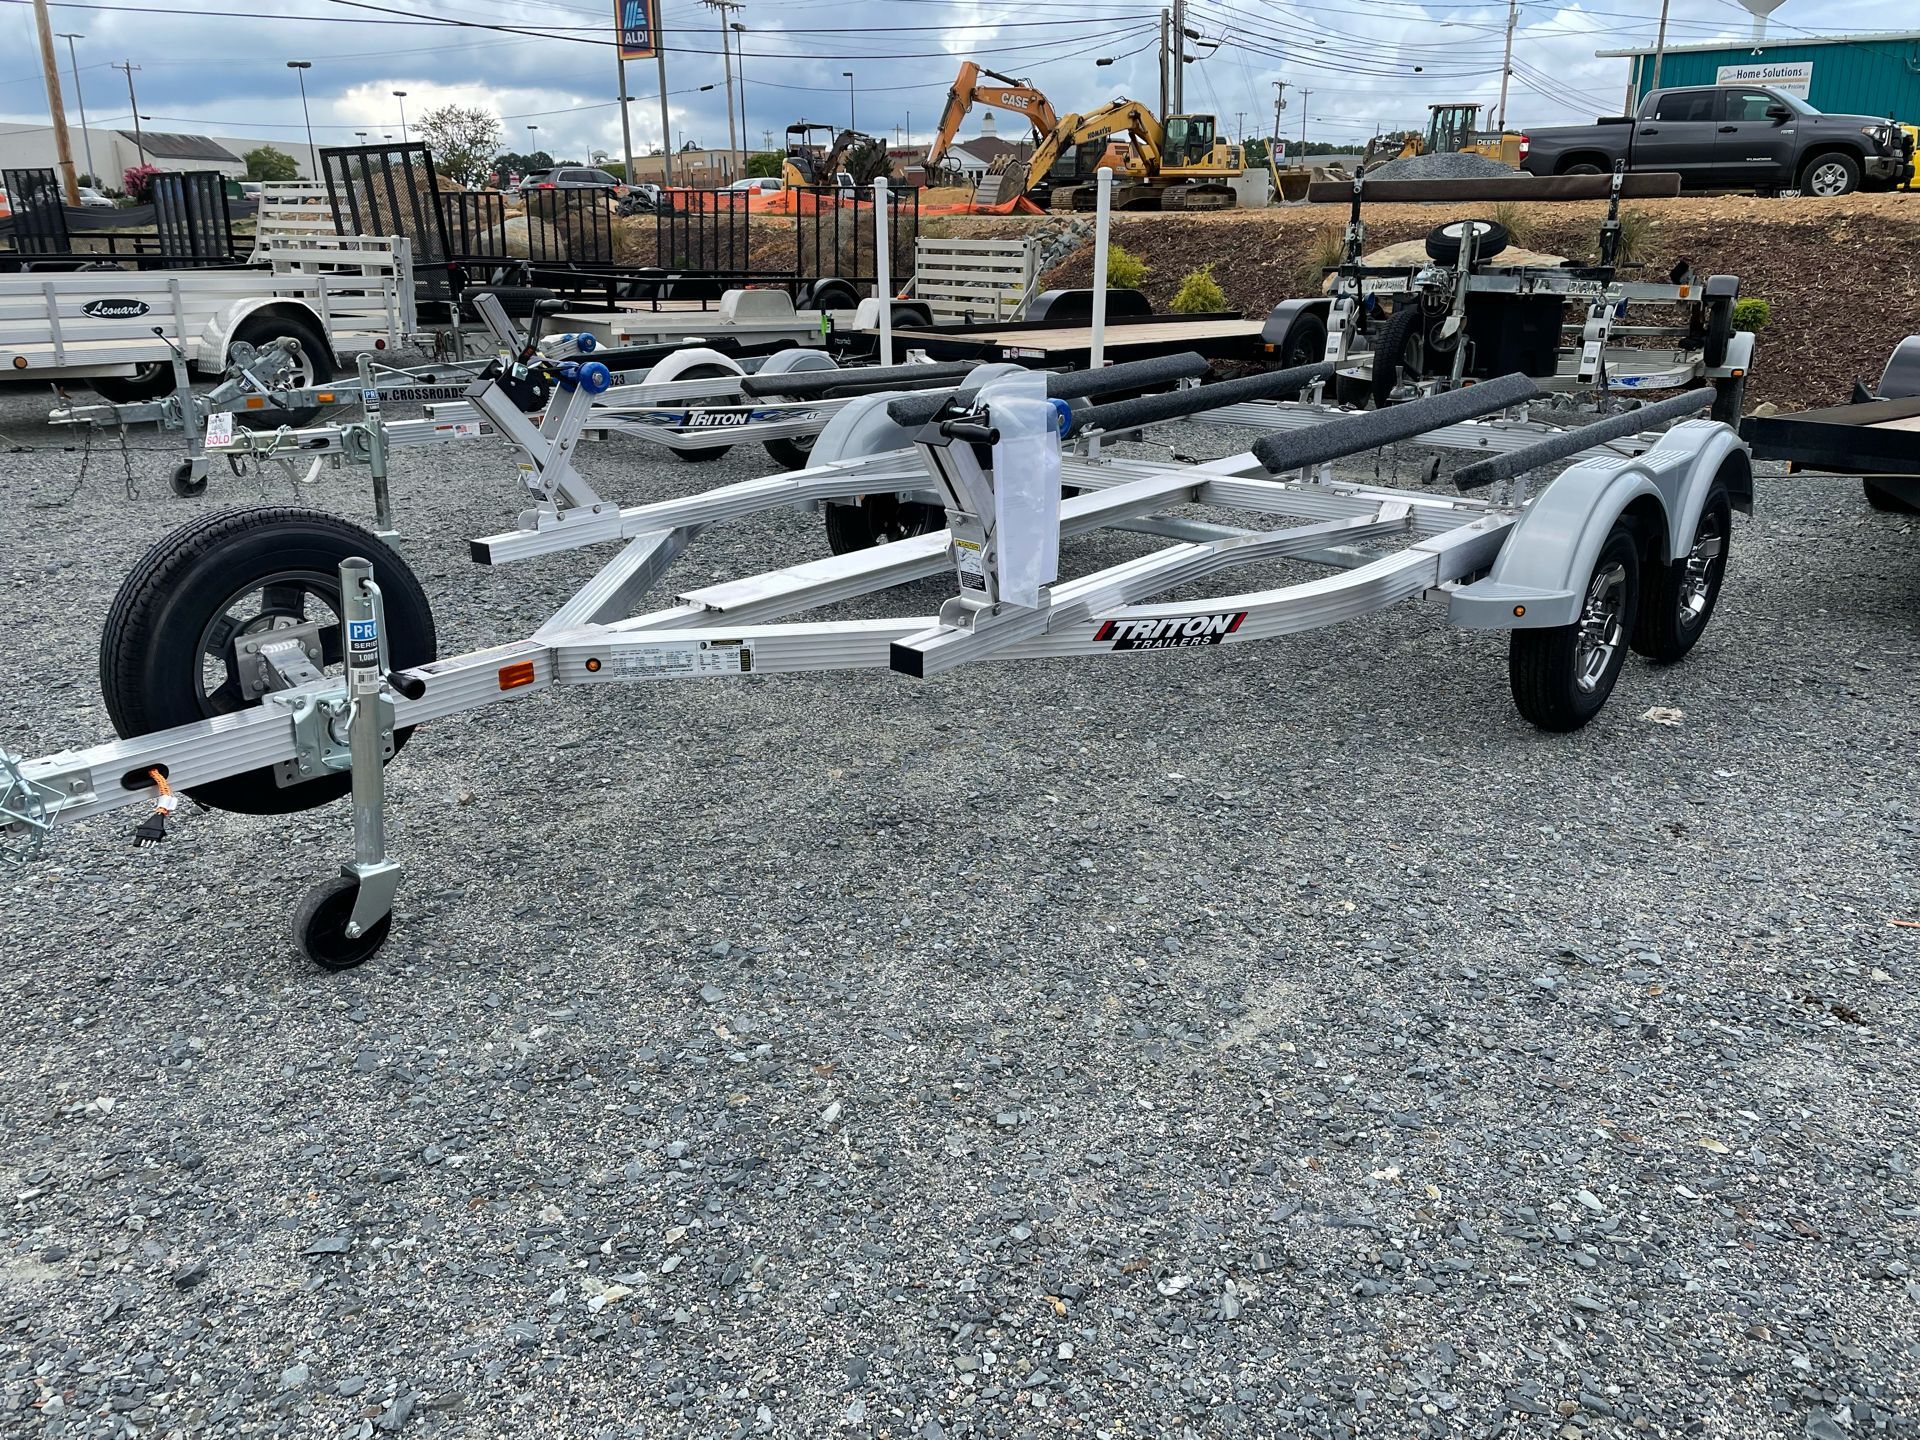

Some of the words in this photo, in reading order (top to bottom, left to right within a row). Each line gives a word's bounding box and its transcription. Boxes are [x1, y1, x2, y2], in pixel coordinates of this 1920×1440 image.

[624, 31, 648, 45] ALDI
[1736, 69, 1761, 79] Home
[1763, 67, 1802, 78] Solutions
[1001, 92, 1029, 109] CASE
[1088, 126, 1112, 140] KOMATSU
[90, 301, 142, 315] Leonard
[688, 409, 748, 426] TRITON
[206, 434, 230, 446] SOLD
[1111, 614, 1236, 641] TRITON
[1132, 636, 1212, 649] TRAILERS
